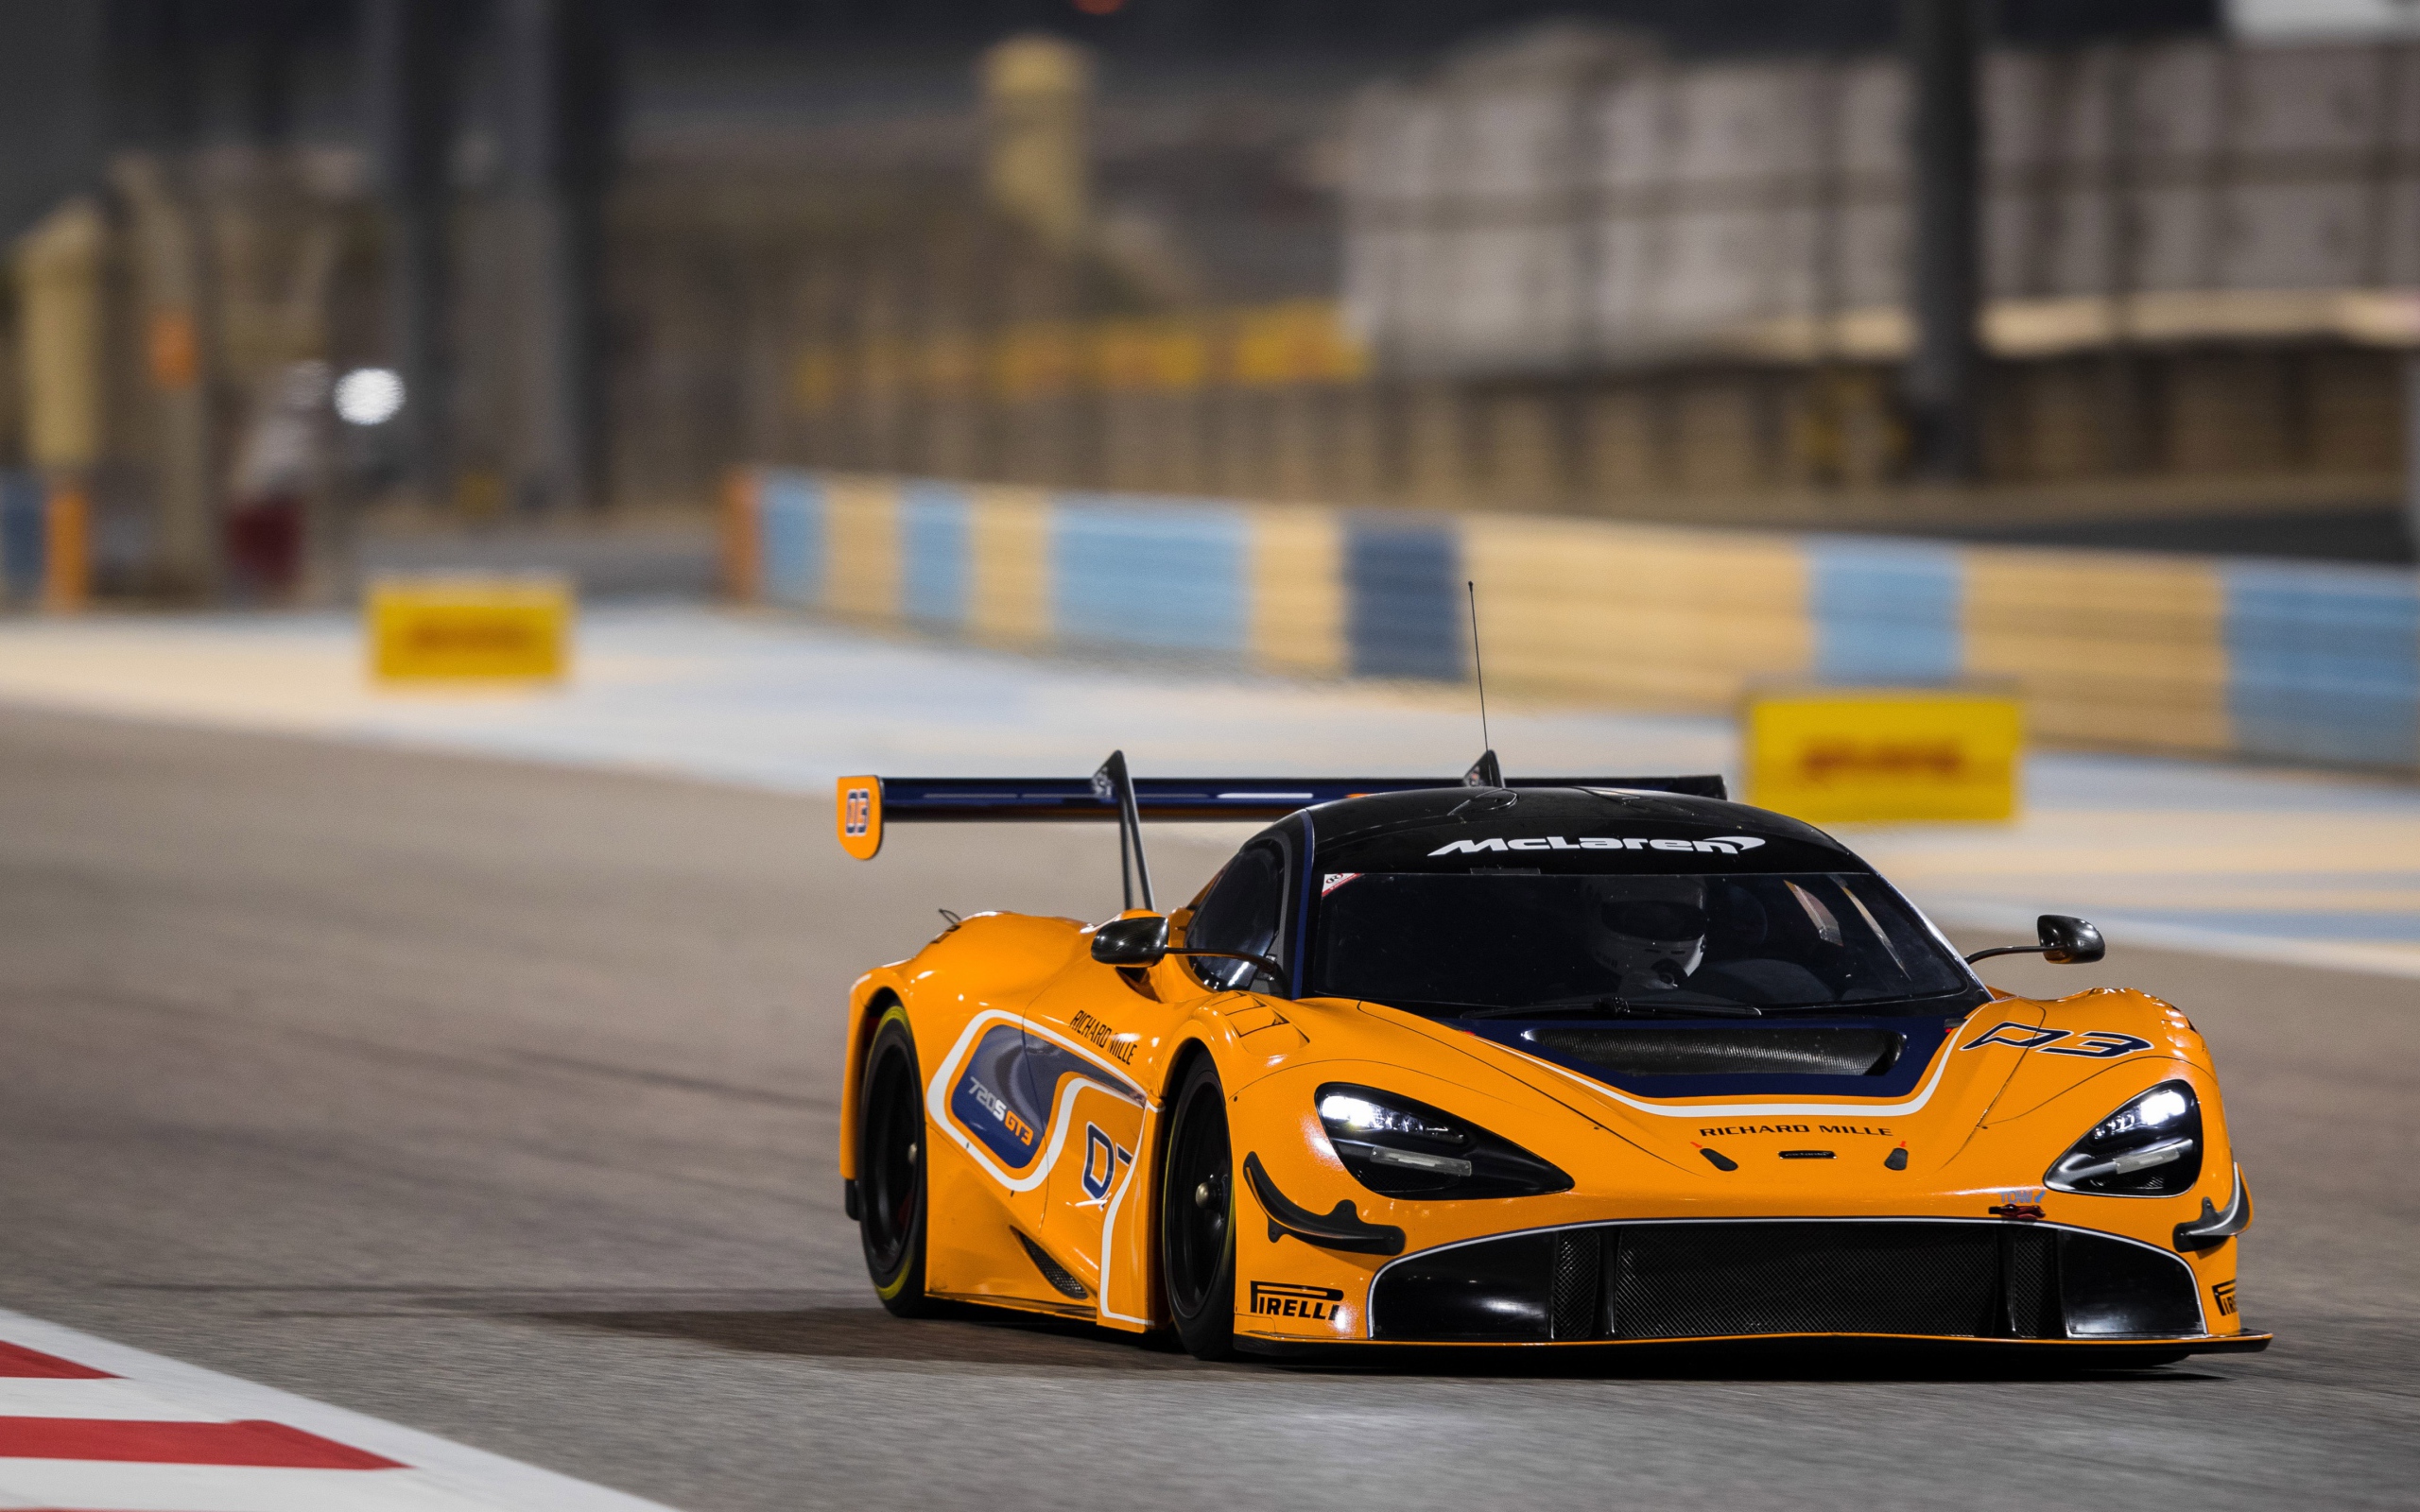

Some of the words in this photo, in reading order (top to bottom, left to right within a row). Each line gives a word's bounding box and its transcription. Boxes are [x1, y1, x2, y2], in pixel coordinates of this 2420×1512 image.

[1427, 836, 1738, 855] McLaren
[1069, 1009, 1112, 1049] RICHARD
[1107, 1033, 1137, 1066] MILLE
[969, 1075, 1007, 1122] 720S
[1005, 1109, 1034, 1146] GT3
[1700, 1125, 1810, 1138] RICHARD
[1819, 1125, 1894, 1137] MILLE
[1998, 1190, 2033, 1204] TOW
[1250, 1280, 1344, 1321] PIRELLI
